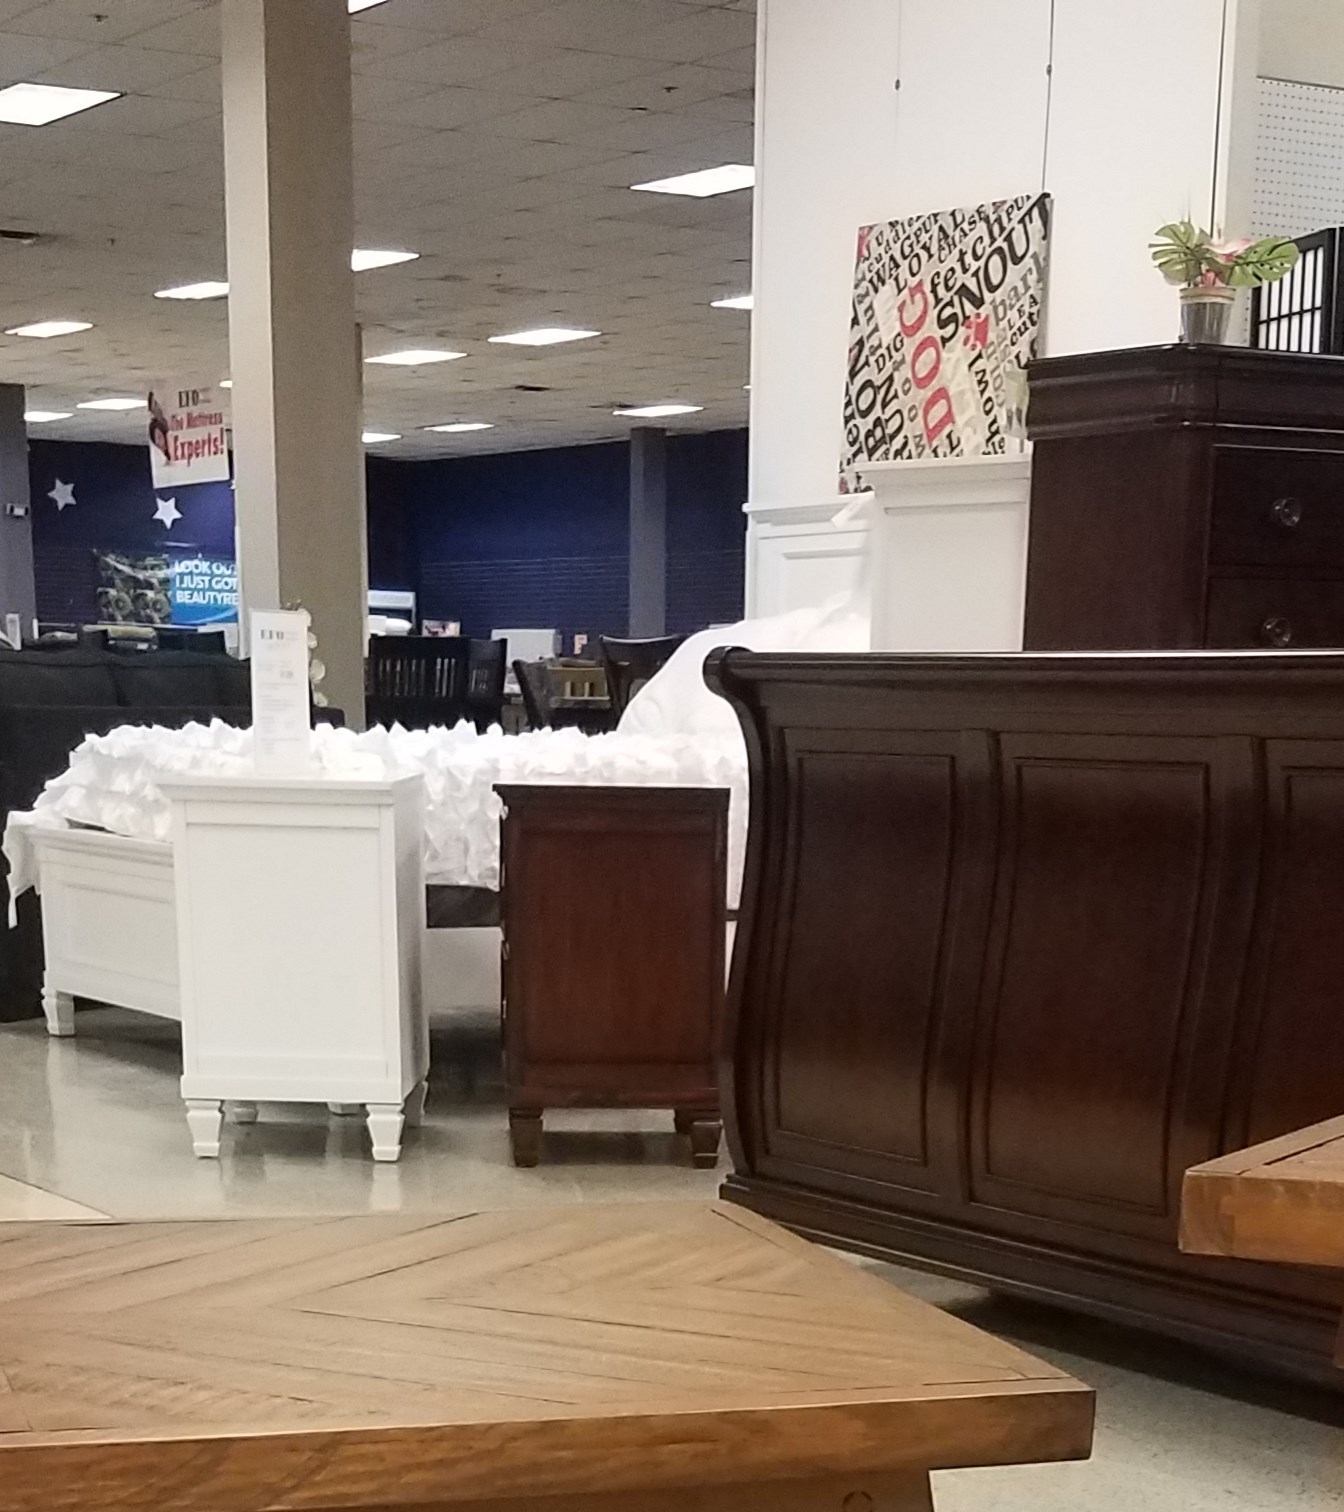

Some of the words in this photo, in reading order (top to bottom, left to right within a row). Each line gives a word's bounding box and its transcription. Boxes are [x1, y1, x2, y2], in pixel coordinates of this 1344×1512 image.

[869, 234, 914, 295] WAG
[894, 208, 966, 296] LOYAL
[930, 215, 1006, 309] fetch
[931, 192, 1052, 350] SNOUT
[875, 332, 905, 375] DIG
[897, 278, 954, 447] DOG
[173, 427, 224, 467] Experts!
[174, 560, 211, 574] LOOK
[181, 576, 211, 588] JUST
